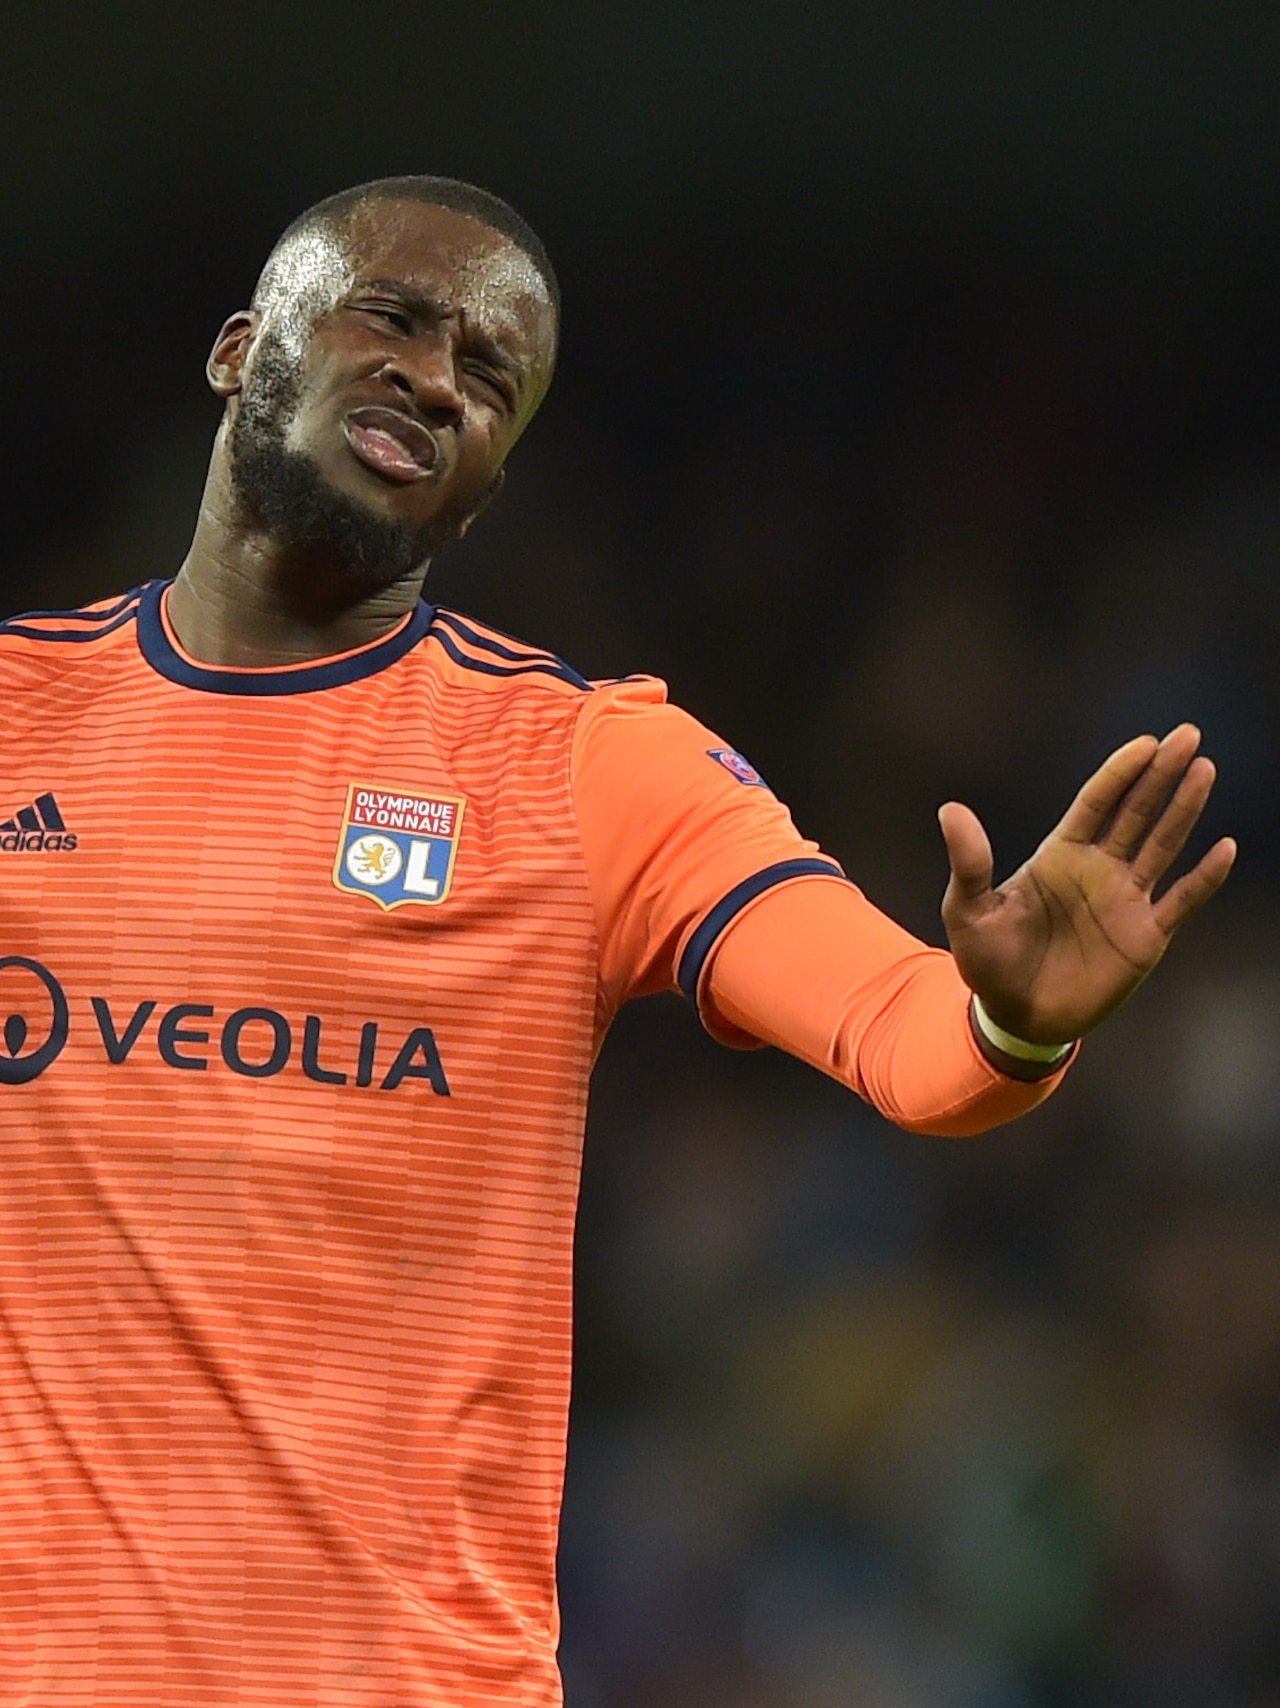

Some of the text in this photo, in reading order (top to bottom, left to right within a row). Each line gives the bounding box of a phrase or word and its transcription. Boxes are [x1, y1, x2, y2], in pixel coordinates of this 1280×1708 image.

[356, 791, 454, 819] OLYMPIQUE
[354, 806, 451, 834] LYONNAIS
[90, 996, 451, 1096] VEOLIA
